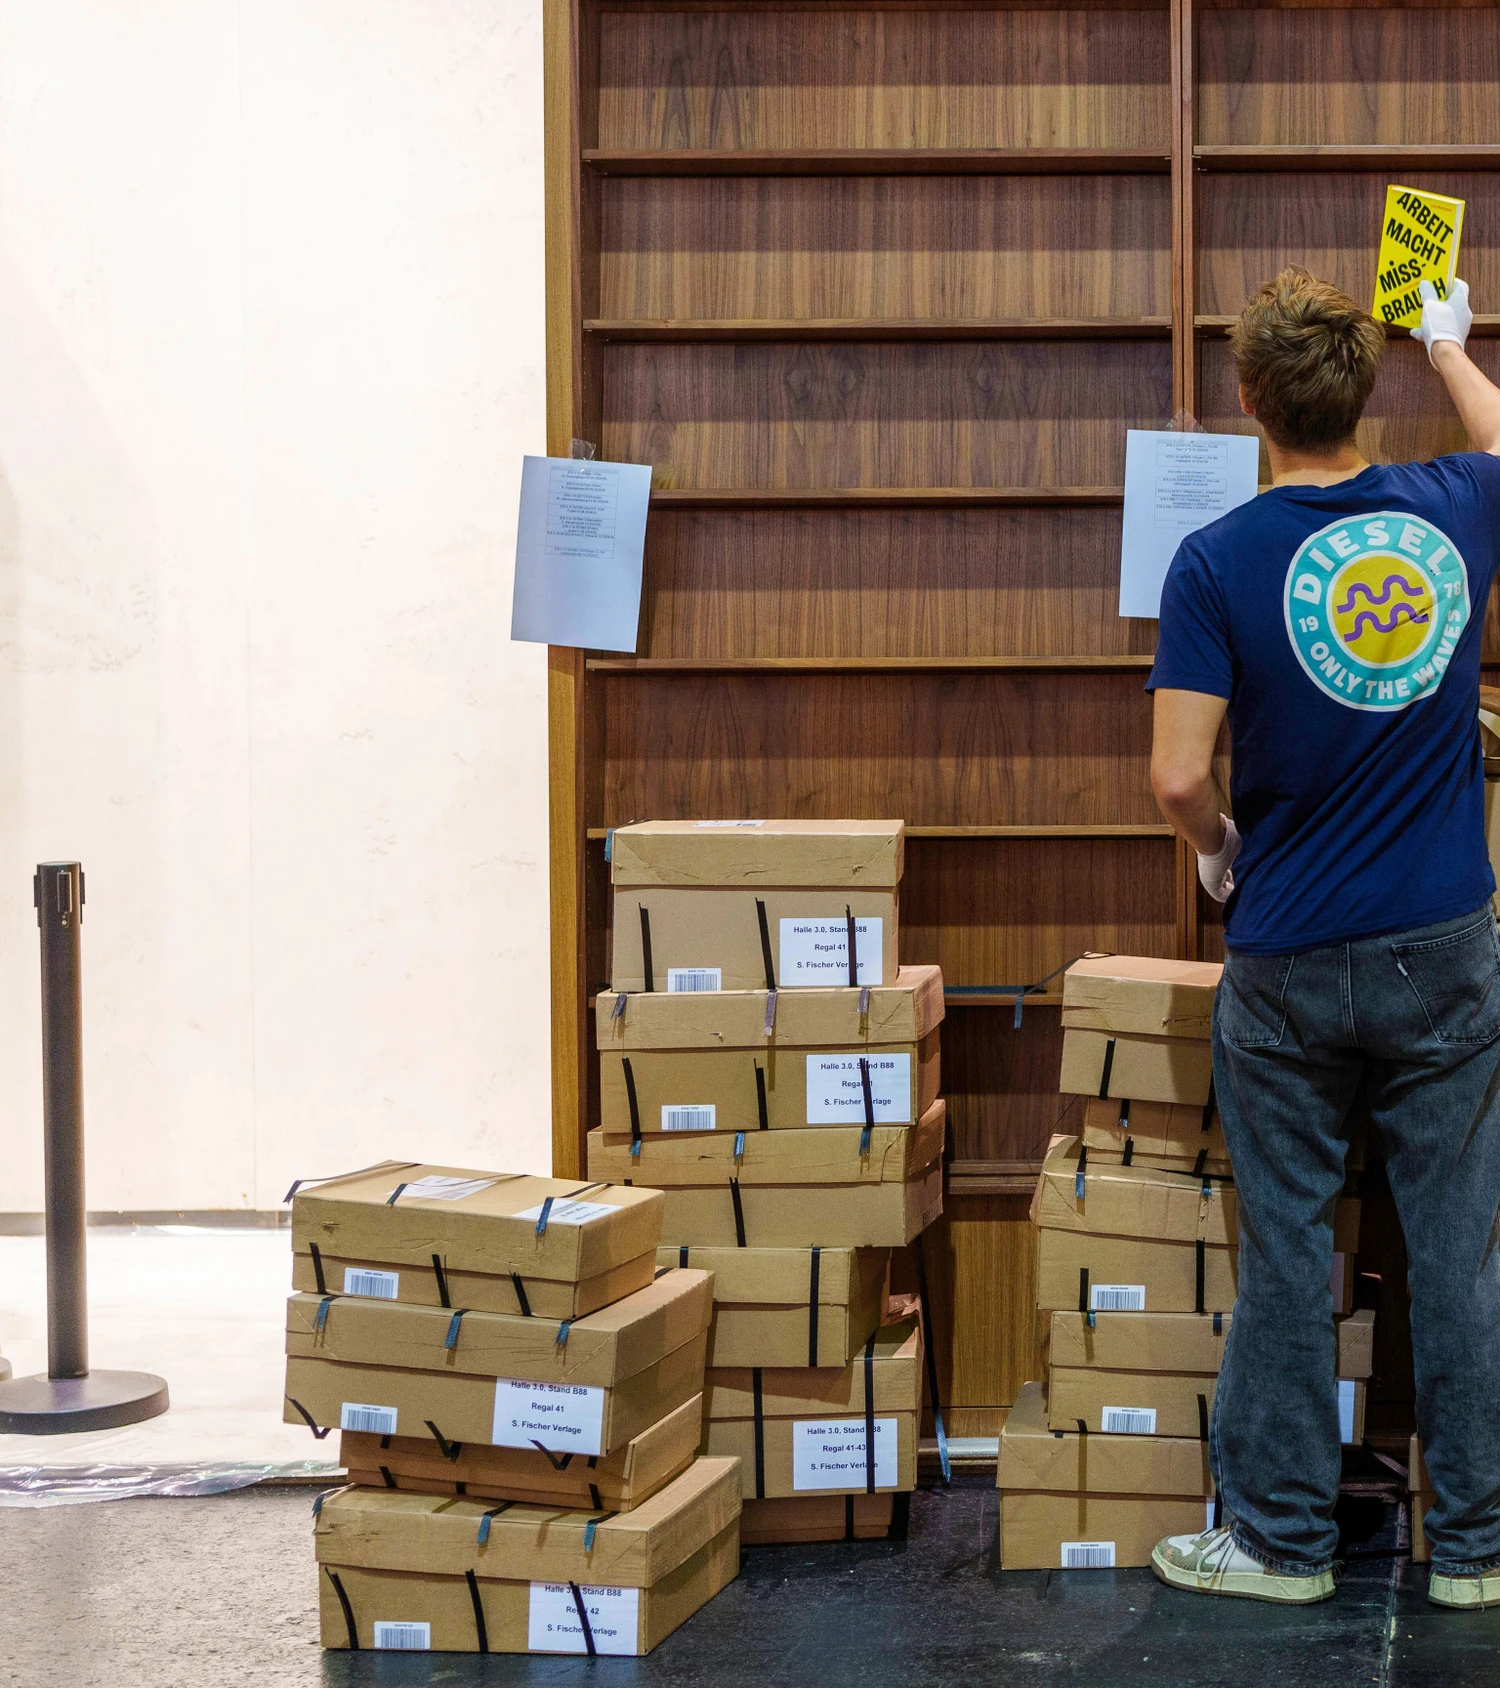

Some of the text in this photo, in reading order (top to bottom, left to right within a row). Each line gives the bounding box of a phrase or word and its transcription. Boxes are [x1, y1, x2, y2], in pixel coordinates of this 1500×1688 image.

[1397, 192, 1453, 243] ARBEIT
[1386, 218, 1446, 266] MACHT
[1381, 277, 1446, 323] BRAUH
[1293, 520, 1449, 605] DIESEL
[1299, 581, 1462, 633] 19 78
[1310, 610, 1461, 700] ONLY THE WAVES
[815, 944, 835, 952] Regal
[511, 1381, 530, 1389] Halle
[533, 1383, 546, 1392] 3.0,
[549, 1385, 570, 1393] Stand
[532, 1403, 553, 1412] Regal
[522, 1421, 550, 1430] Fischer
[553, 1424, 581, 1434] Verlage
